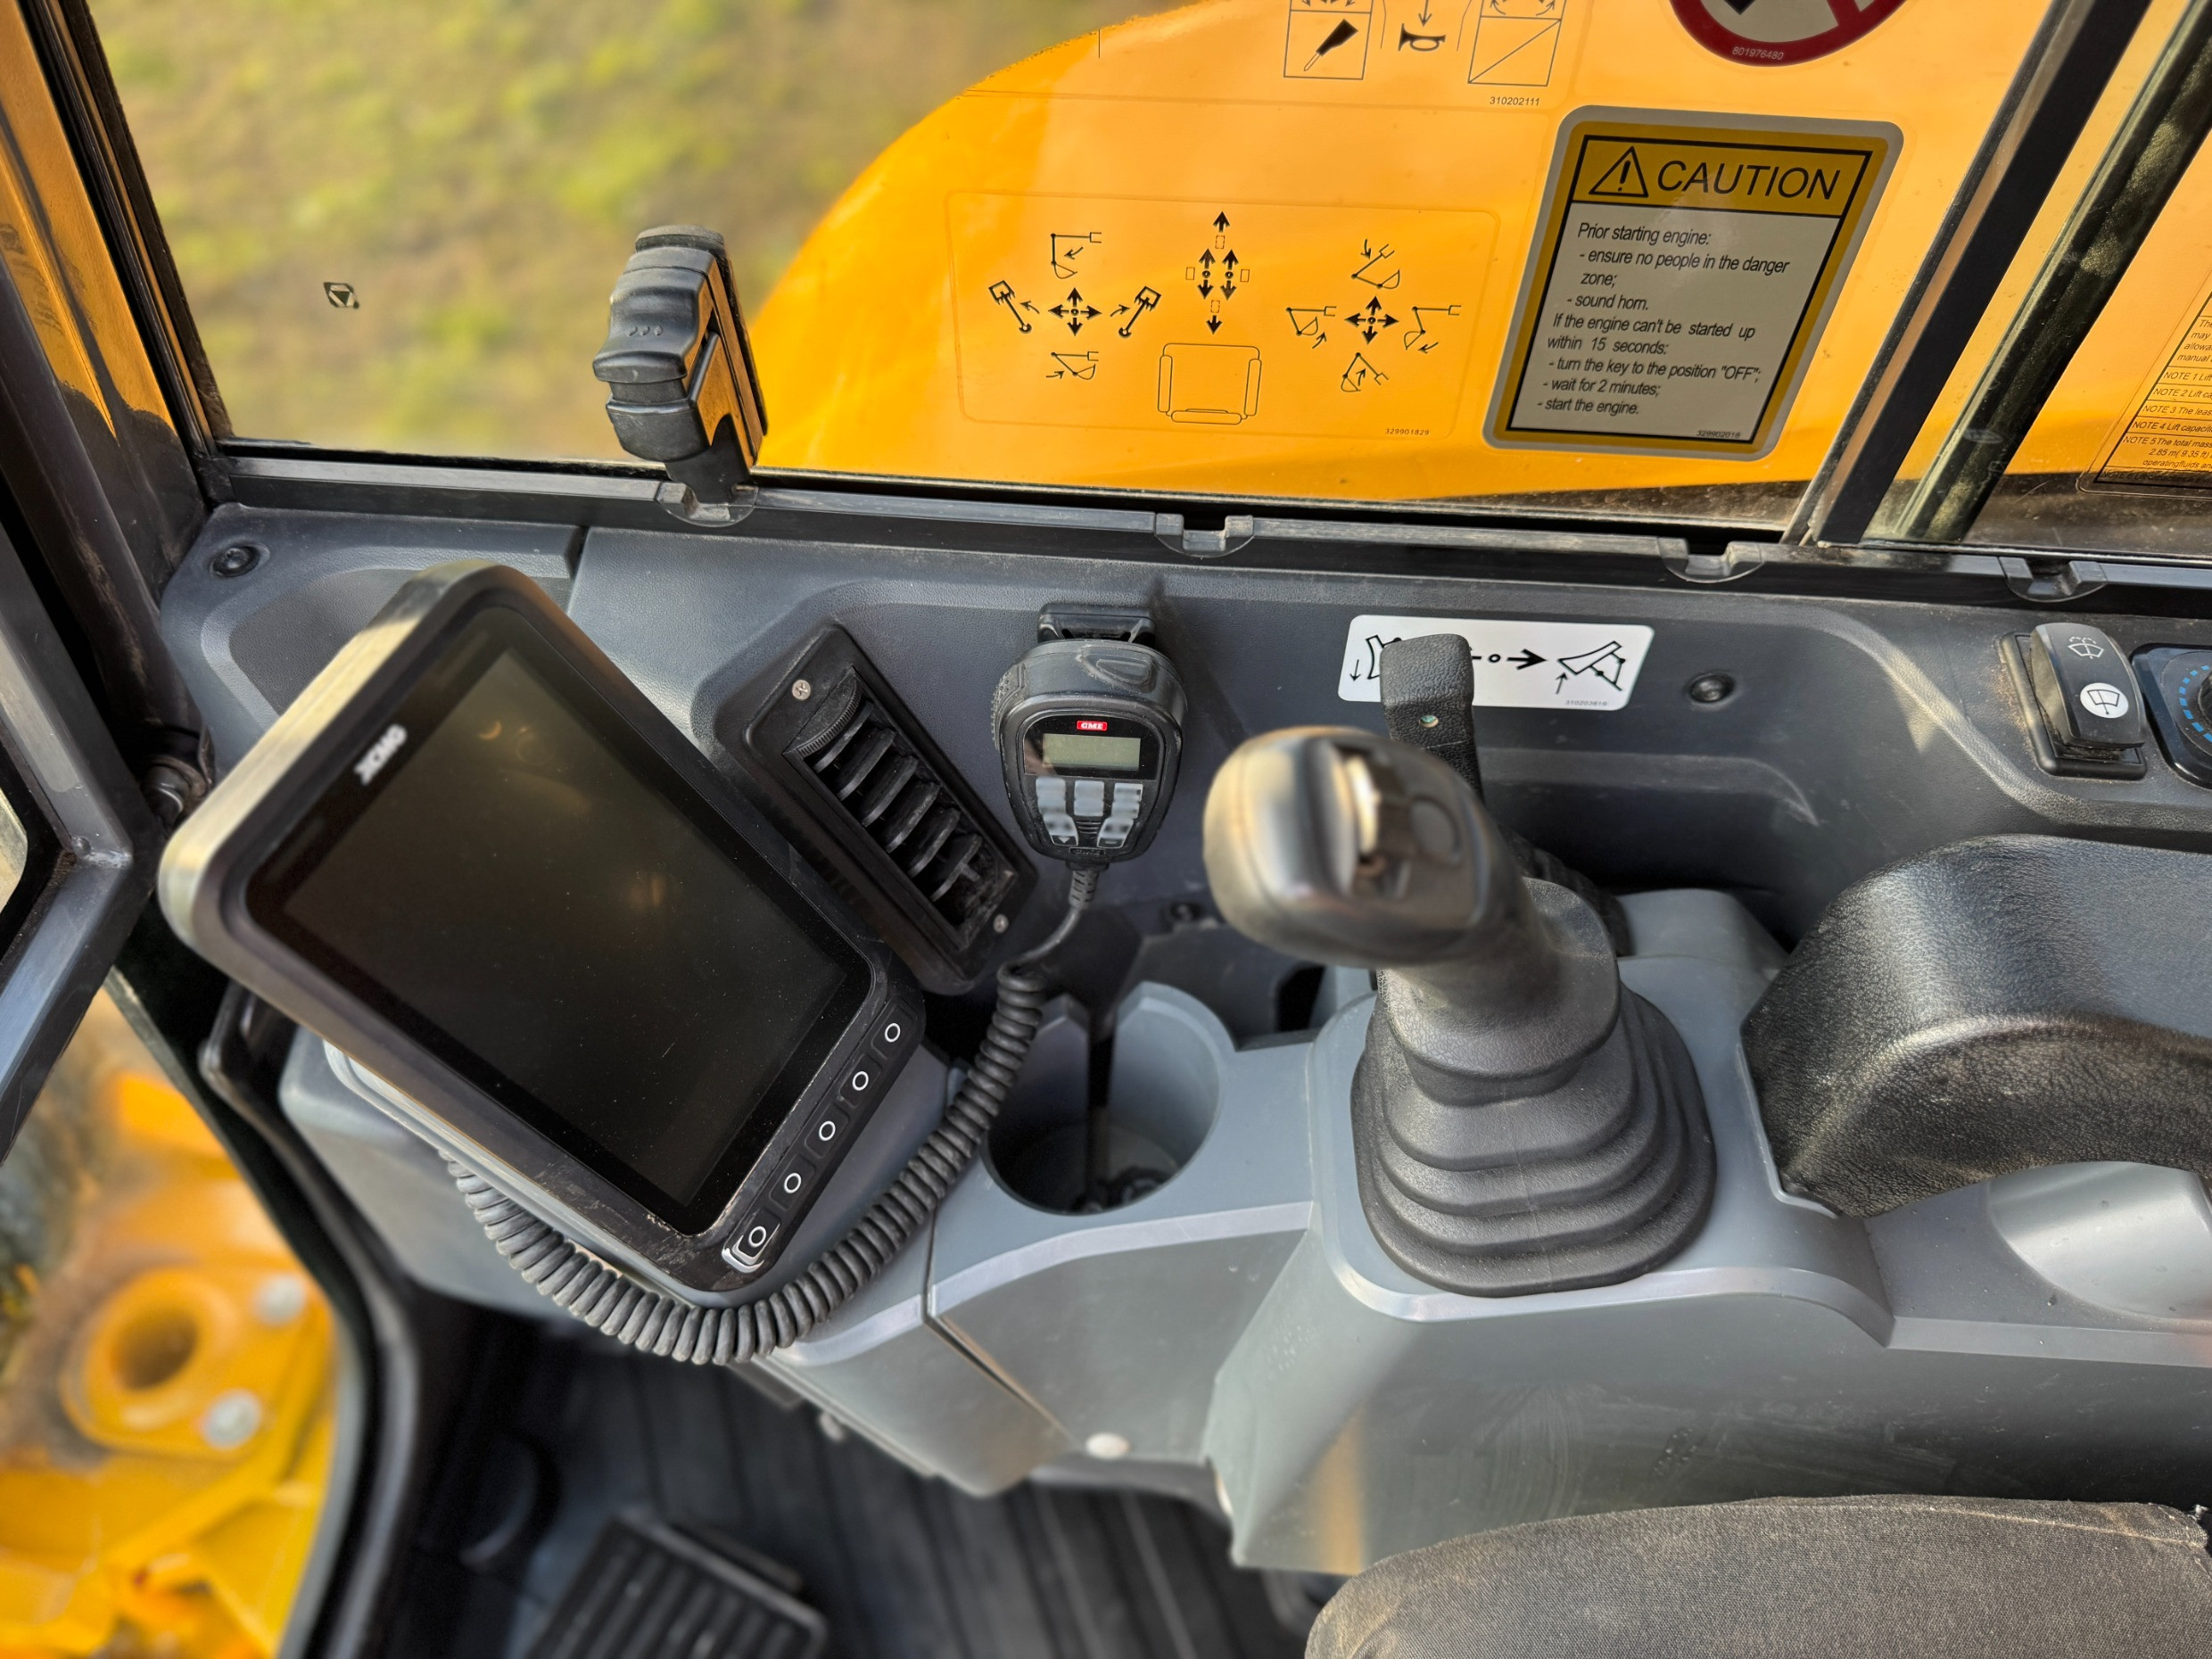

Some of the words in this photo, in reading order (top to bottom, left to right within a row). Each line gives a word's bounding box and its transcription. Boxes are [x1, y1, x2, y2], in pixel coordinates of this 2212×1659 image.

[1732, 46, 1784, 61] 801976480
[1490, 95, 1540, 106] 310202111
[1657, 160, 1841, 201] CAUTION
[1577, 222, 1610, 239] Prior
[1611, 227, 1660, 245] starting
[1662, 231, 1712, 247] engine:
[1588, 249, 1633, 265] ensure
[1635, 252, 1653, 266] no
[1655, 252, 1700, 270] people
[1702, 253, 1715, 269] in
[1718, 254, 1739, 270] the
[1742, 255, 1790, 276] danger
[1581, 272, 1617, 287] zone;
[1574, 293, 1615, 310] sound
[1617, 294, 1649, 311] horn.
[1553, 312, 1564, 328] If
[1564, 314, 1584, 329] the
[1587, 317, 1630, 334] engine
[1632, 319, 1664, 334] can't
[1664, 319, 1682, 334] be
[1688, 322, 1733, 338] started
[1738, 325, 1755, 341] up
[2199, 319, 2212, 328] The
[2191, 332, 2211, 342] may
[1548, 335, 1582, 351] within
[1590, 337, 1606, 351] 15
[1612, 338, 1669, 355] seconds:
[2183, 343, 2212, 351] allowa
[2176, 354, 2211, 362] manual
[1556, 357, 1582, 371] turn
[1583, 358, 1604, 373] the
[1605, 359, 1628, 376] key
[1631, 361, 1644, 375] to
[1647, 361, 1666, 376] the
[1667, 364, 1716, 379] position
[1721, 366, 1762, 384] "OFF";
[2163, 371, 2191, 380] NOTE
[2199, 373, 2212, 382] Lift
[1551, 377, 1577, 392] wait
[1578, 378, 1596, 392] for
[1597, 379, 1606, 392] 2
[1609, 380, 1661, 397] minutes;
[2152, 388, 2181, 397] NOTE
[2181, 389, 2188, 397] 2
[2188, 389, 2202, 398] Lift
[1544, 397, 1572, 411] start
[1574, 399, 1594, 412] the
[1596, 400, 1639, 417] engine.
[2142, 405, 2169, 413] NOTE
[2169, 406, 2176, 414] 3
[2177, 407, 2194, 415] The
[2194, 408, 2212, 416] leas
[1385, 427, 1430, 436] 329901829
[2132, 421, 2159, 430] NOTE
[2159, 422, 2167, 430] 4
[2167, 423, 2181, 432] Lift
[2123, 436, 2150, 445] NOTE
[2150, 437, 2157, 445] 5
[2157, 438, 2173, 446] The
[2173, 439, 2191, 447] total
[2149, 448, 2169, 457] 2.85
[2180, 450, 2200, 458] 9.35
[1080, 722, 1104, 730] GME
